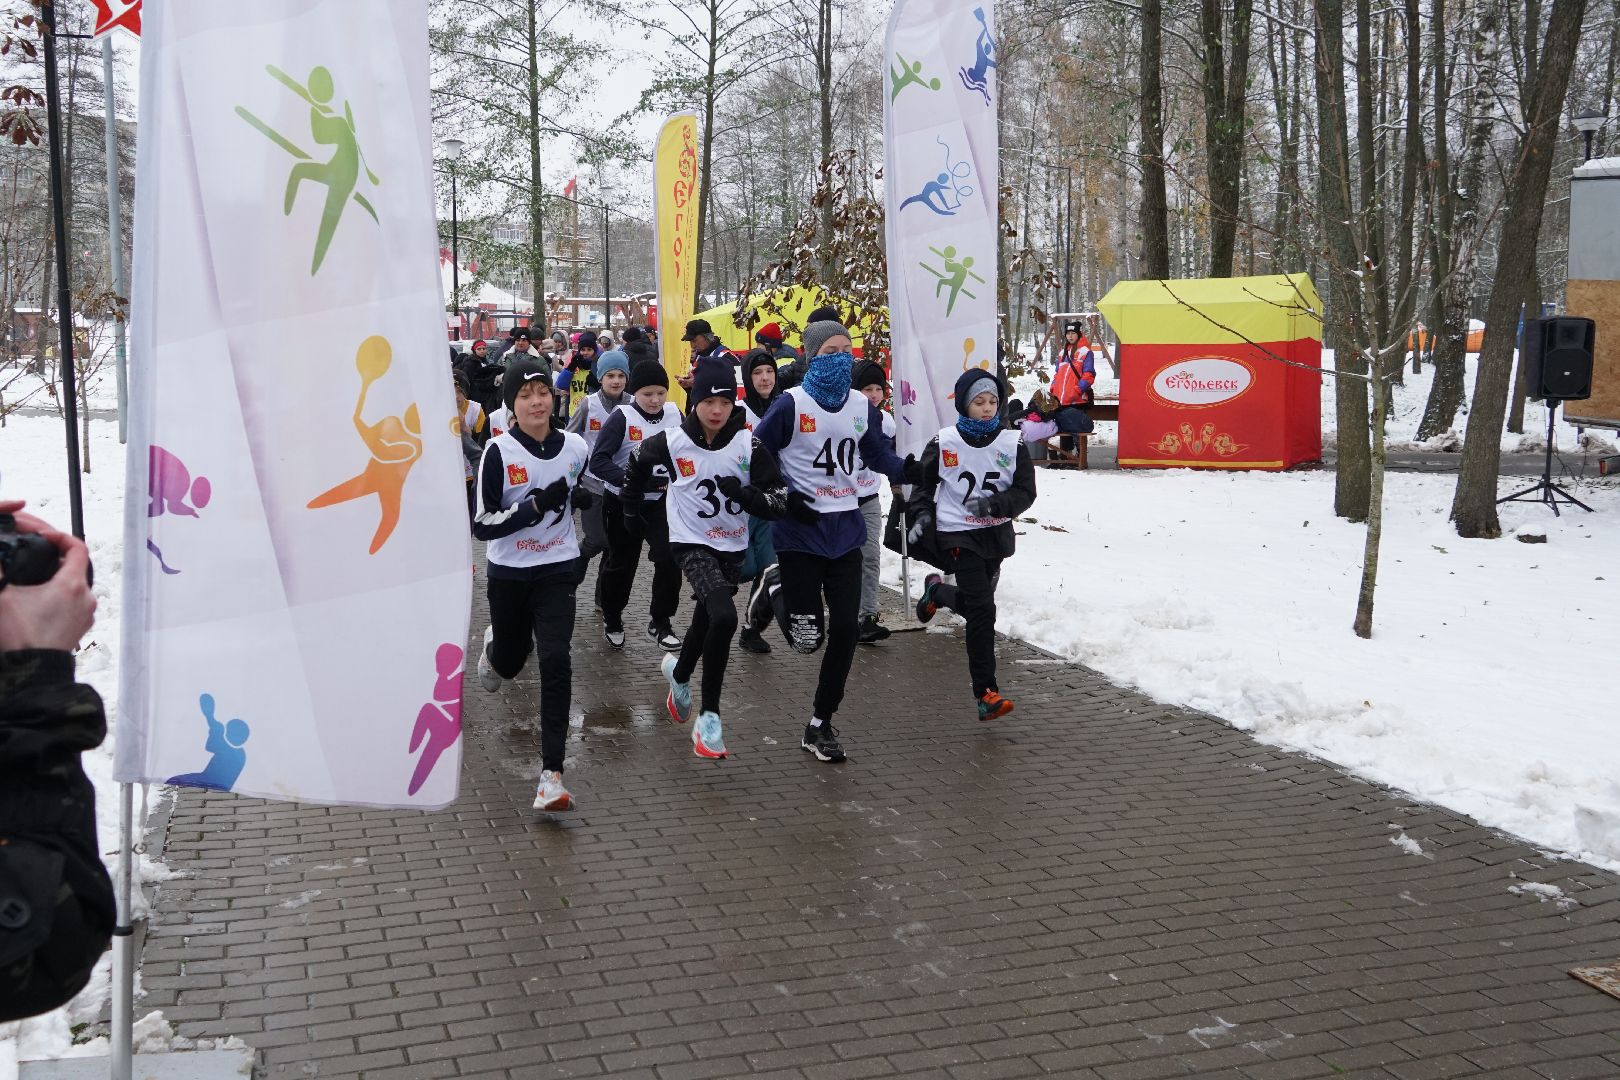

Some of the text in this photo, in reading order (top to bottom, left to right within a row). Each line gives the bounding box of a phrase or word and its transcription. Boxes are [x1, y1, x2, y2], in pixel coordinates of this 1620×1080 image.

[1165, 374, 1239, 393] Егорьевск
[813, 437, 856, 477] 40
[958, 470, 1001, 506] 25
